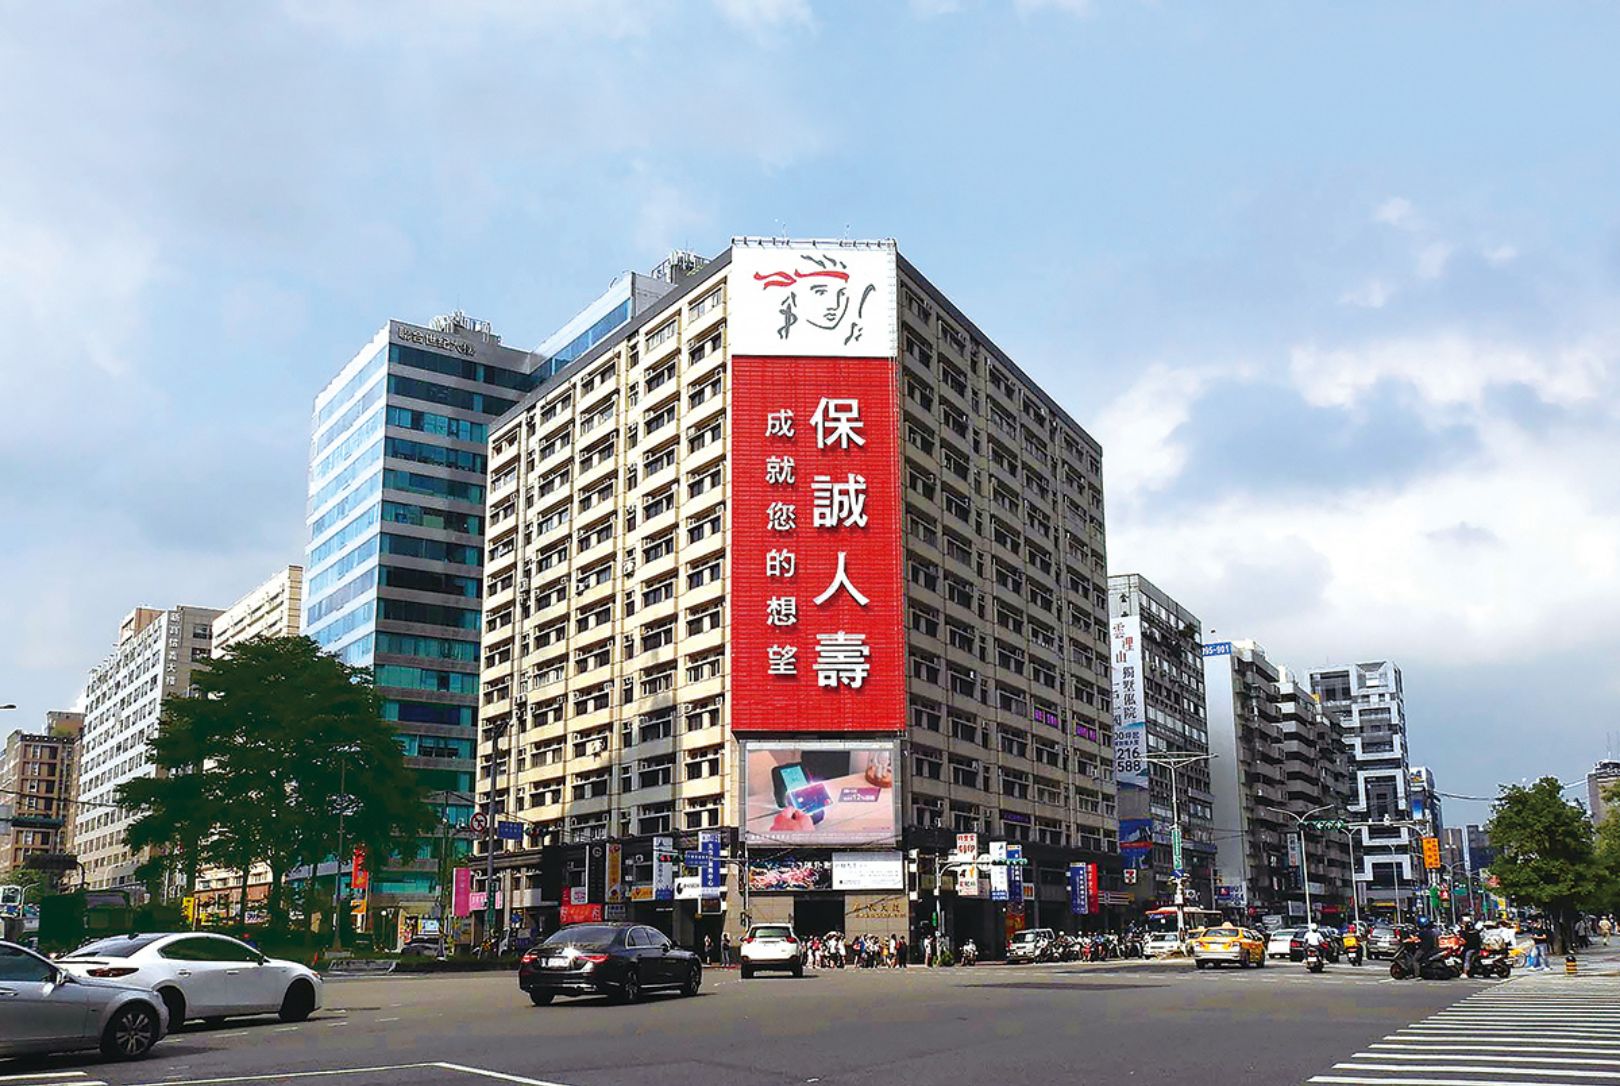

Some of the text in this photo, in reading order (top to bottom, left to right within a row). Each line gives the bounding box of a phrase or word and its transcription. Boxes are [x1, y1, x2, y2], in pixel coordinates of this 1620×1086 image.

[765, 409, 797, 675] 成就您的想望
[810, 397, 869, 688] 保誠人壽
[1117, 747, 1140, 760] 216
[1117, 759, 1141, 773] 588
